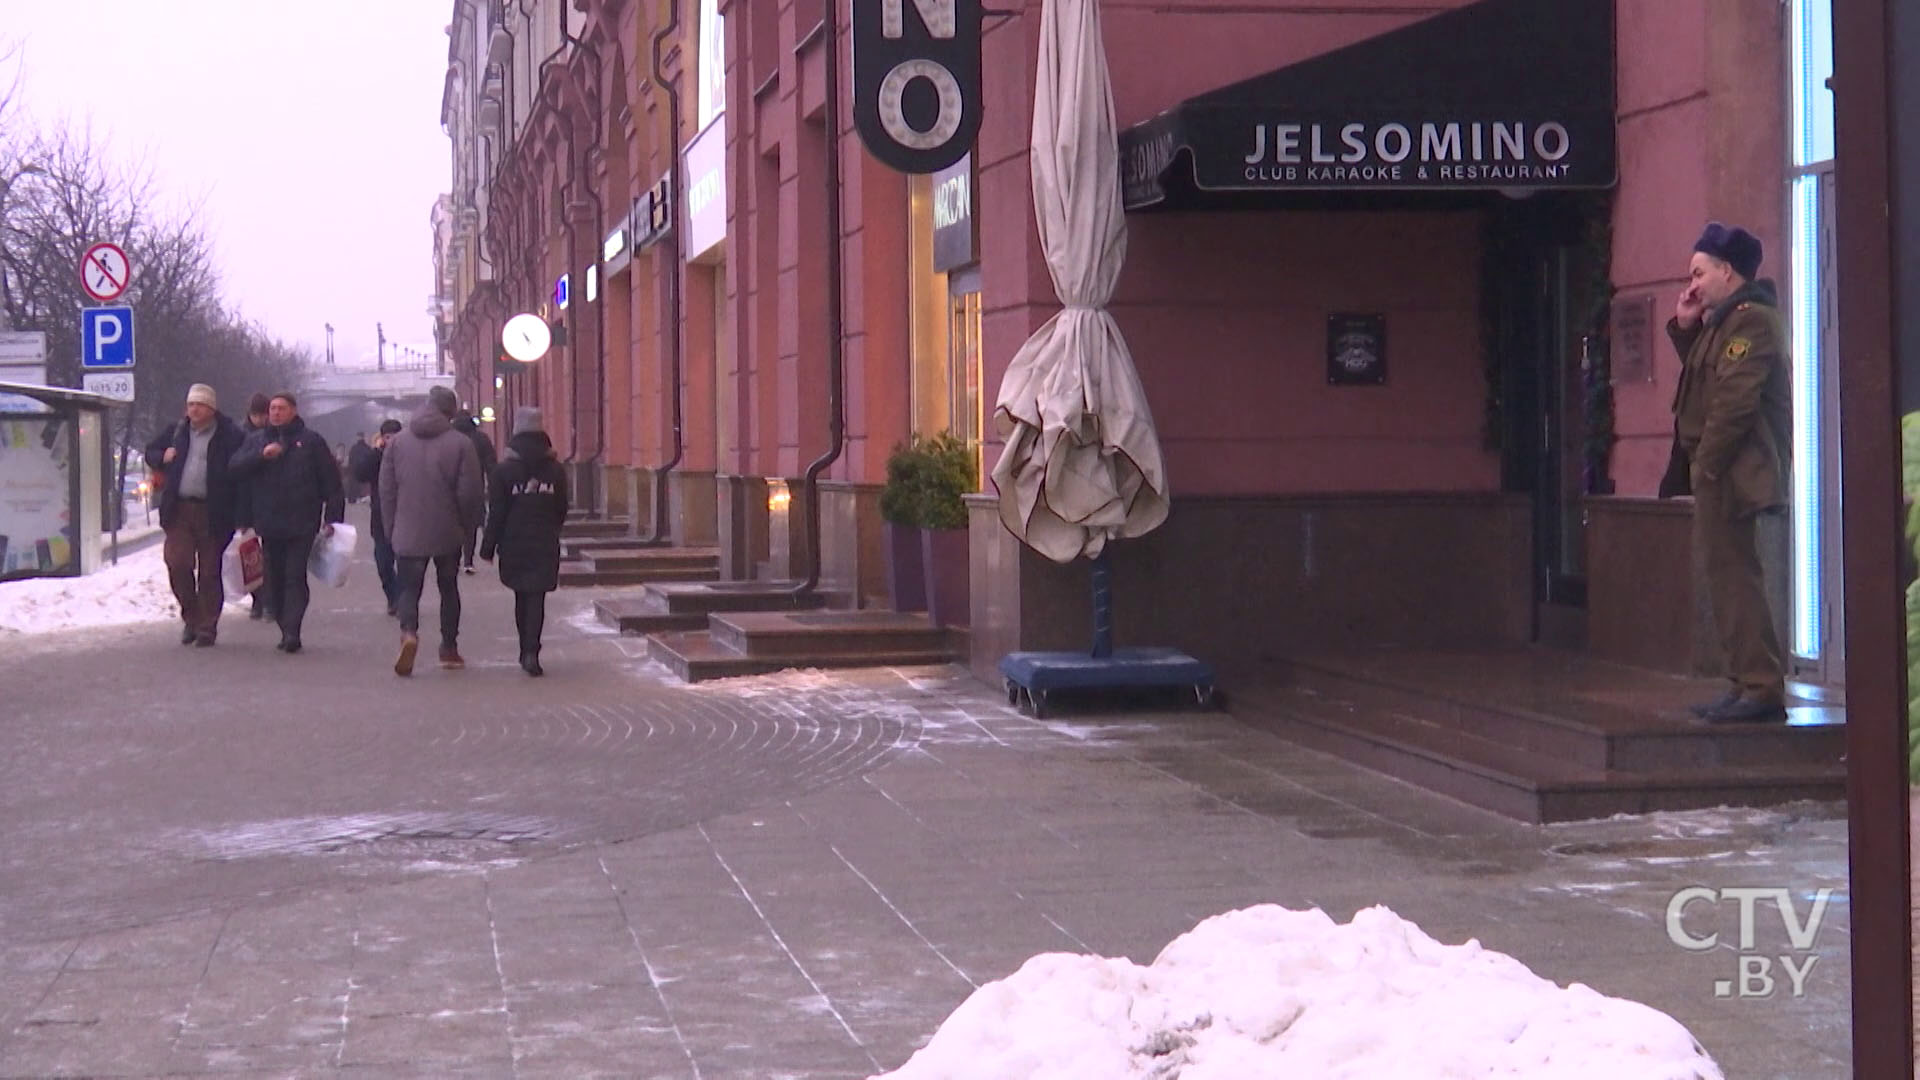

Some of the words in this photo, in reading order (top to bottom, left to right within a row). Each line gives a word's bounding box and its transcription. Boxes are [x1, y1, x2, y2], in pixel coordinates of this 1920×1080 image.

[1244, 121, 1571, 165] JELSOMINO
[1244, 166, 1299, 182] CLUB
[1307, 165, 1402, 181] KARAOKE
[1417, 165, 1429, 180] &
[1439, 164, 1571, 180] RESTAURANT
[94, 314, 122, 360] P
[115, 382, 128, 392] 20
